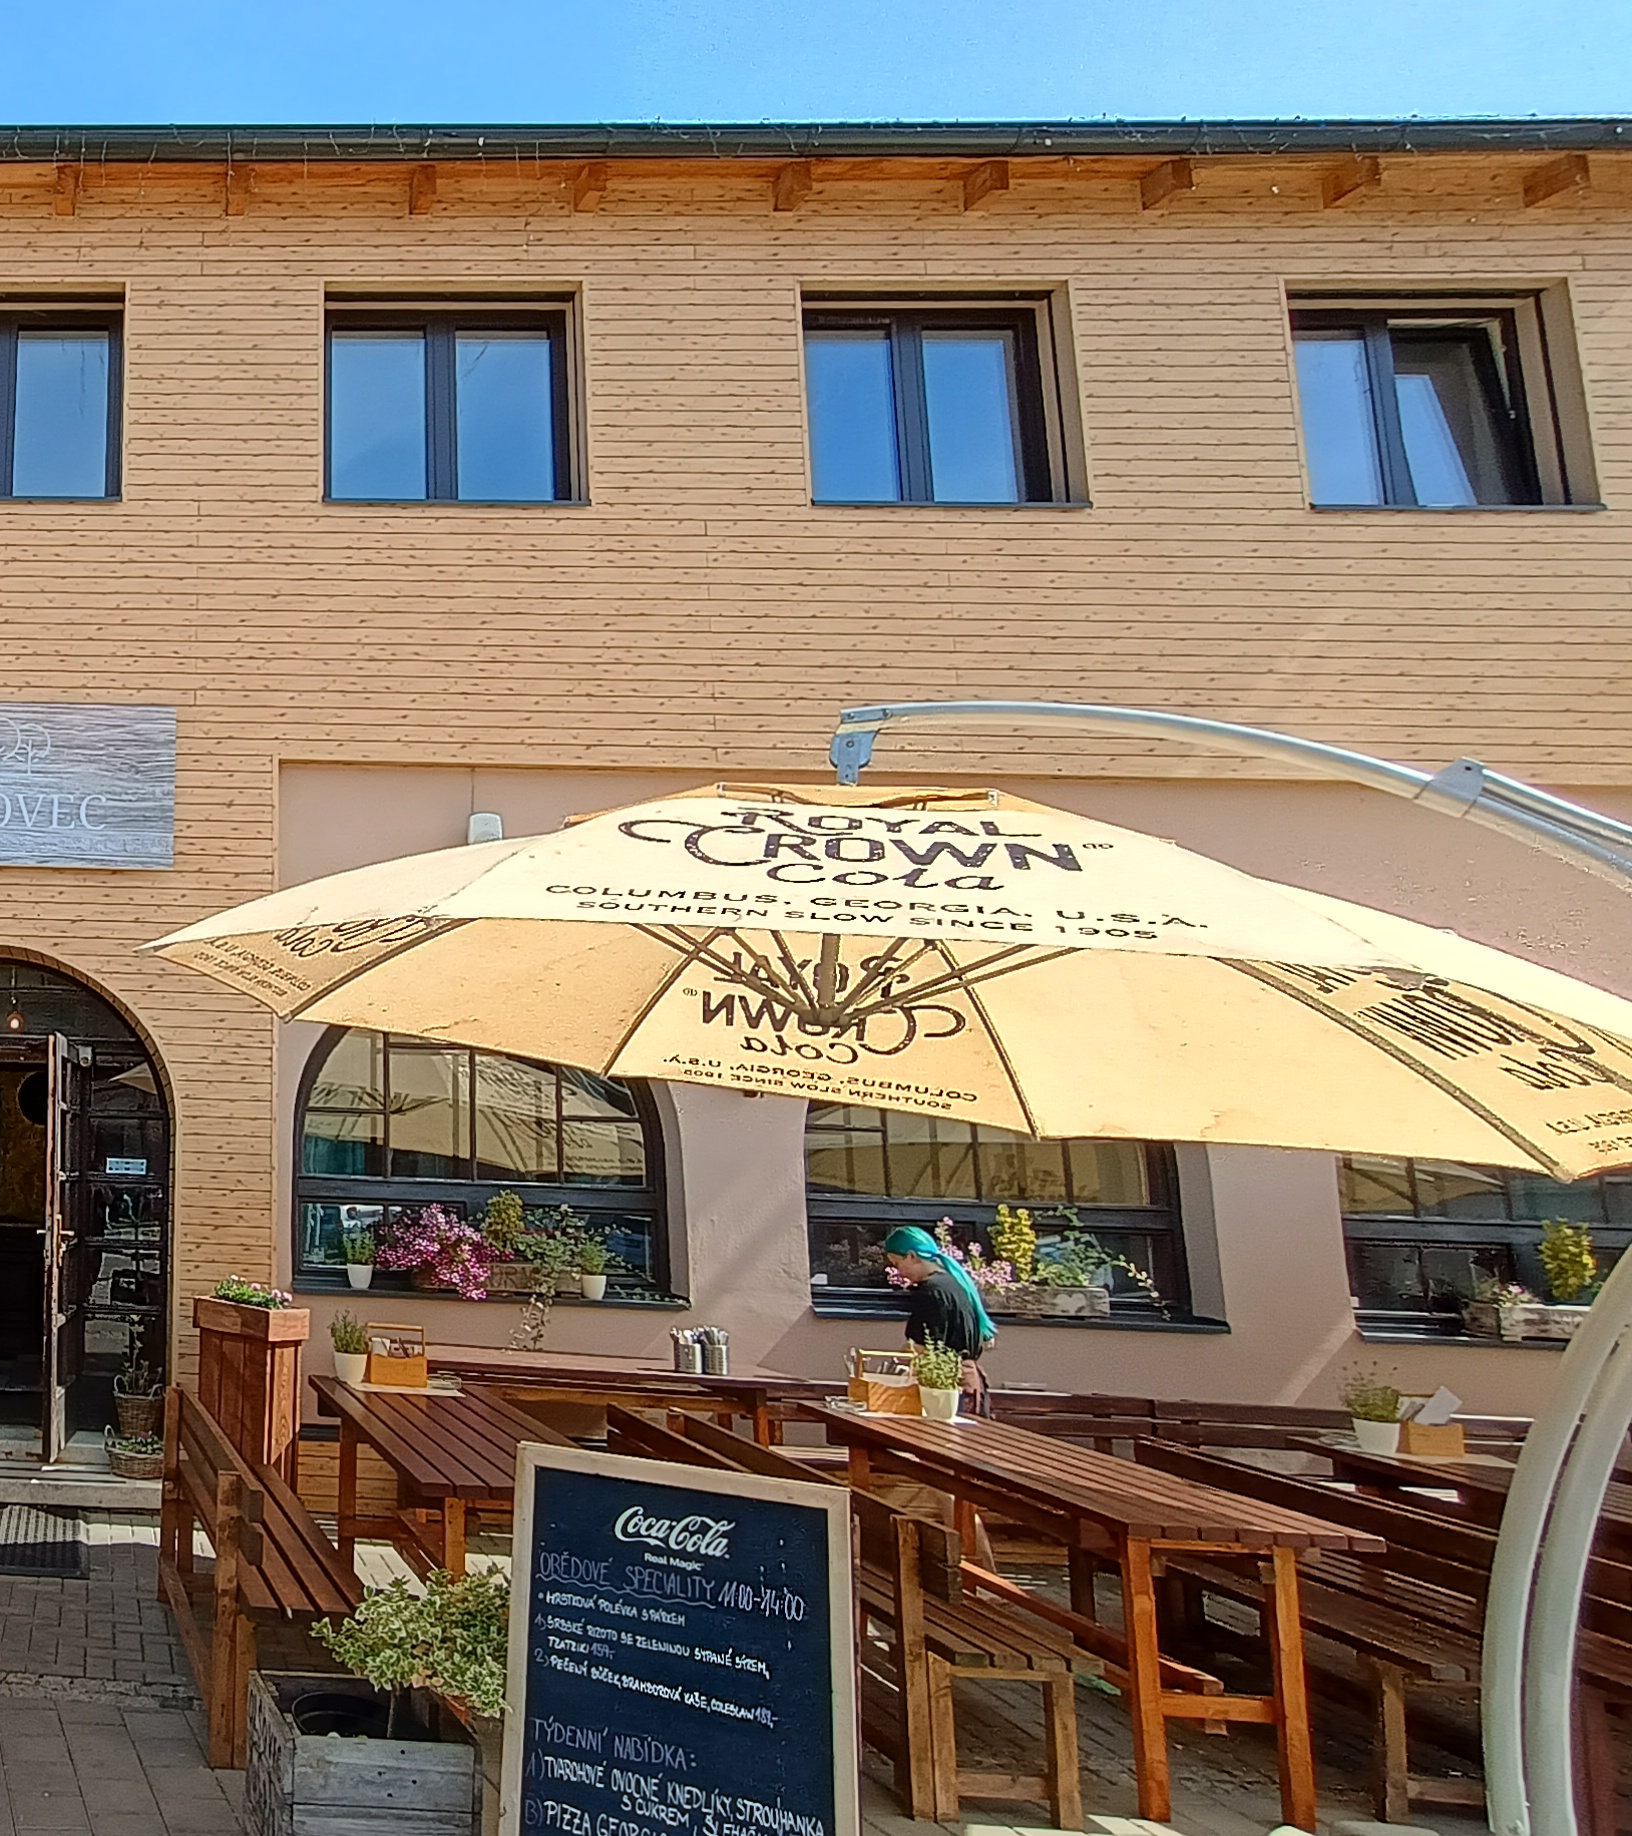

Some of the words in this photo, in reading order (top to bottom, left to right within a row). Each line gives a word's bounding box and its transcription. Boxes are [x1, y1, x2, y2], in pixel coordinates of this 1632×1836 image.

[721, 807, 1043, 837] ROYAL
[618, 818, 1083, 872] CROWN
[766, 863, 1005, 891] Cola
[545, 884, 792, 906] COLUMBUS,
[1056, 909, 1209, 929] U.S.A.
[576, 901, 770, 918] SOUTHERN
[784, 910, 894, 923] SLOW
[909, 916, 1034, 932] SINCE
[1055, 924, 1159, 939] 1905
[614, 1505, 735, 1558] Coca-Cola
[540, 1551, 613, 1585] OBĚDOVÉ
[623, 1566, 716, 1601] SPECIALITY
[644, 1552, 668, 1566] Real
[669, 1557, 704, 1572] Magic
[530, 1715, 609, 1753] TÝDENNÍ
[613, 1734, 698, 1772] NABÍDKA:
[611, 1772, 664, 1802] OVOCNÉ
[620, 1794, 632, 1811] S
[543, 1800, 591, 1836] PIZZA
